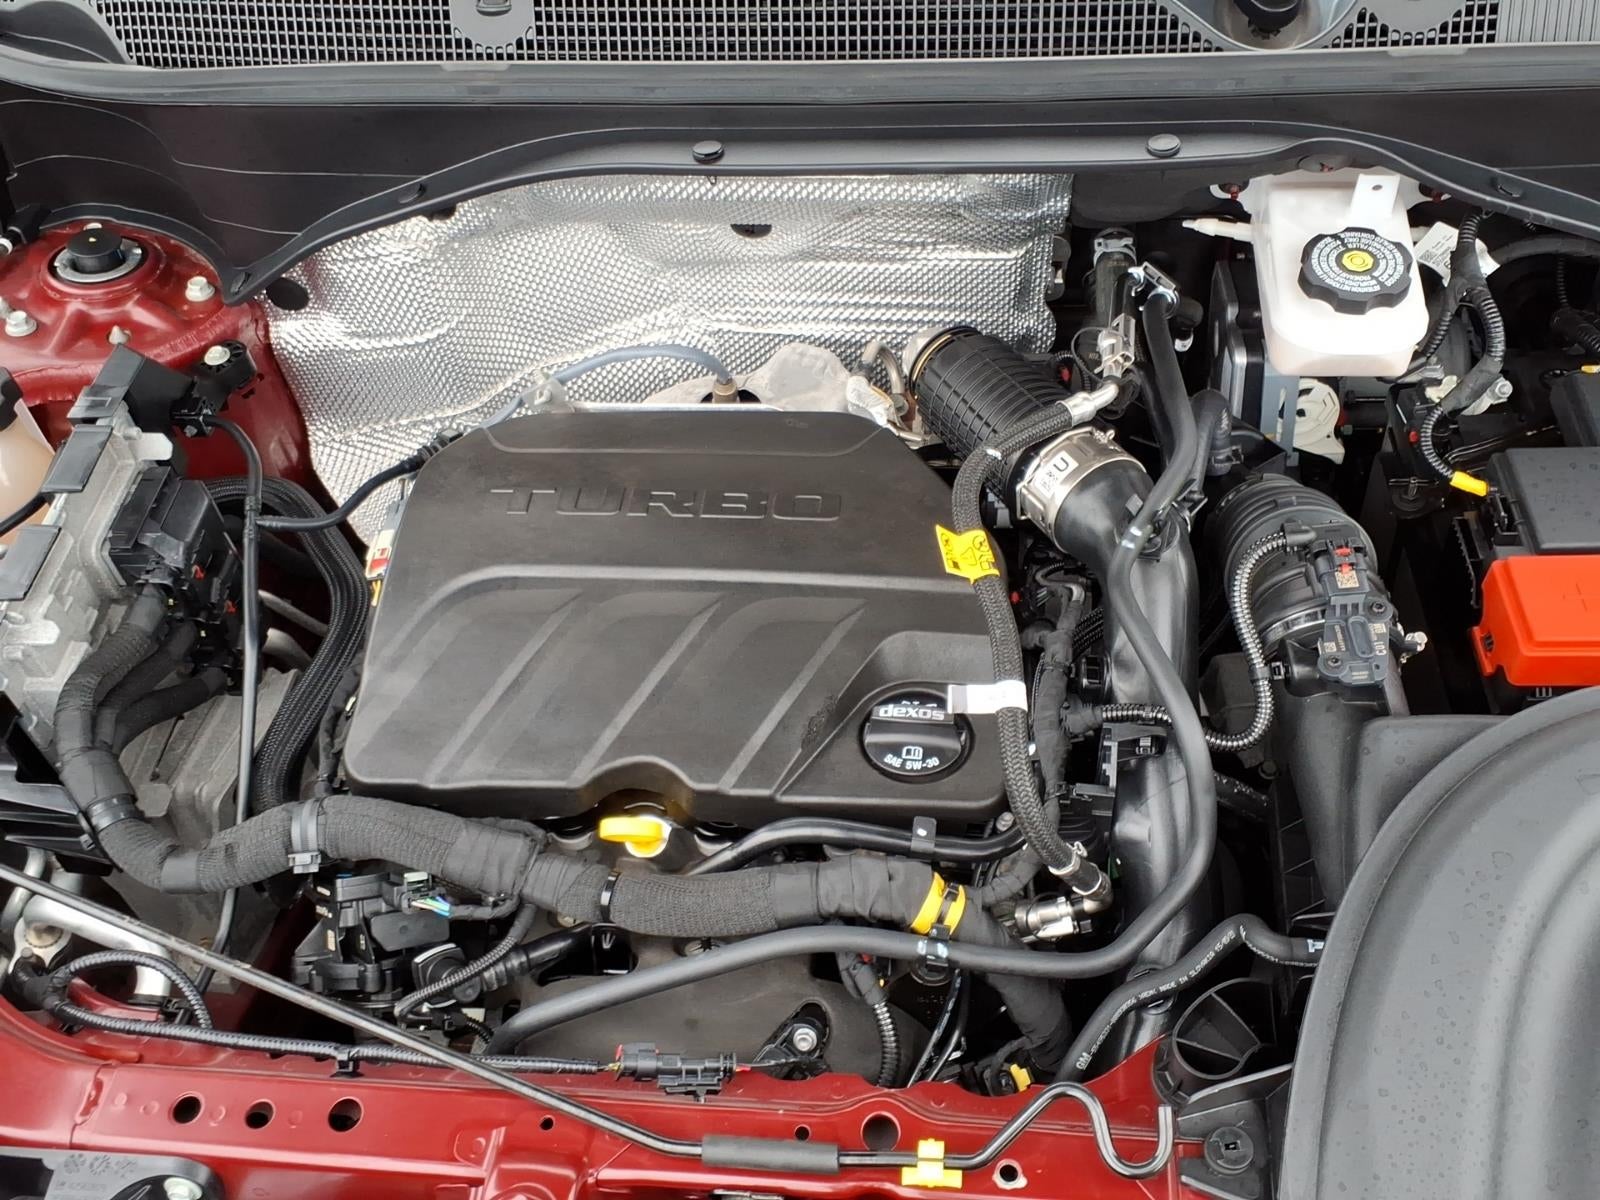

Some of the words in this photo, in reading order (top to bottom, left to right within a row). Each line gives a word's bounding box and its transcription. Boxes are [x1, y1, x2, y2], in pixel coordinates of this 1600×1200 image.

[1053, 457, 1070, 472] U
[490, 487, 842, 521] TURBO
[879, 704, 945, 720] dexos
[884, 754, 903, 768] SAE
[905, 757, 940, 770] 5W-30
